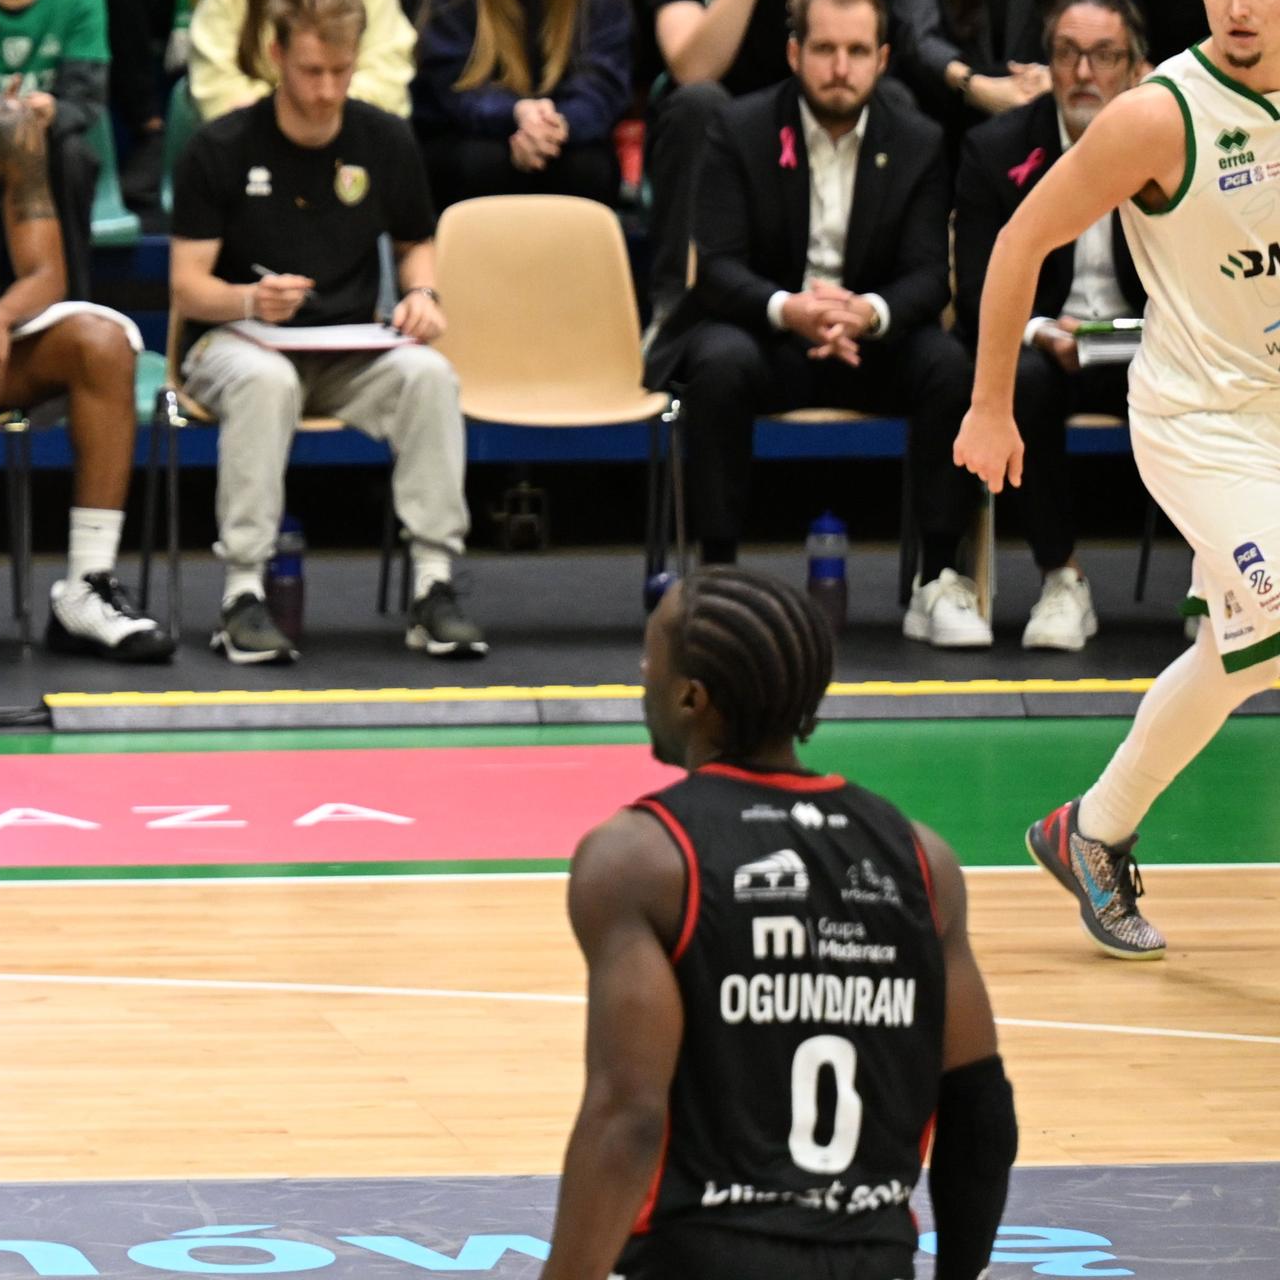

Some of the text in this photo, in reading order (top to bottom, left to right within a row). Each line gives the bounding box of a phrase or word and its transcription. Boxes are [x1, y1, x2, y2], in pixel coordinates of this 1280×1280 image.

[1218, 150, 1255, 170] errea
[1224, 176, 1249, 189] PGE
[720, 973, 916, 1028] OGUNDIRAN
[788, 1034, 863, 1175] 0
